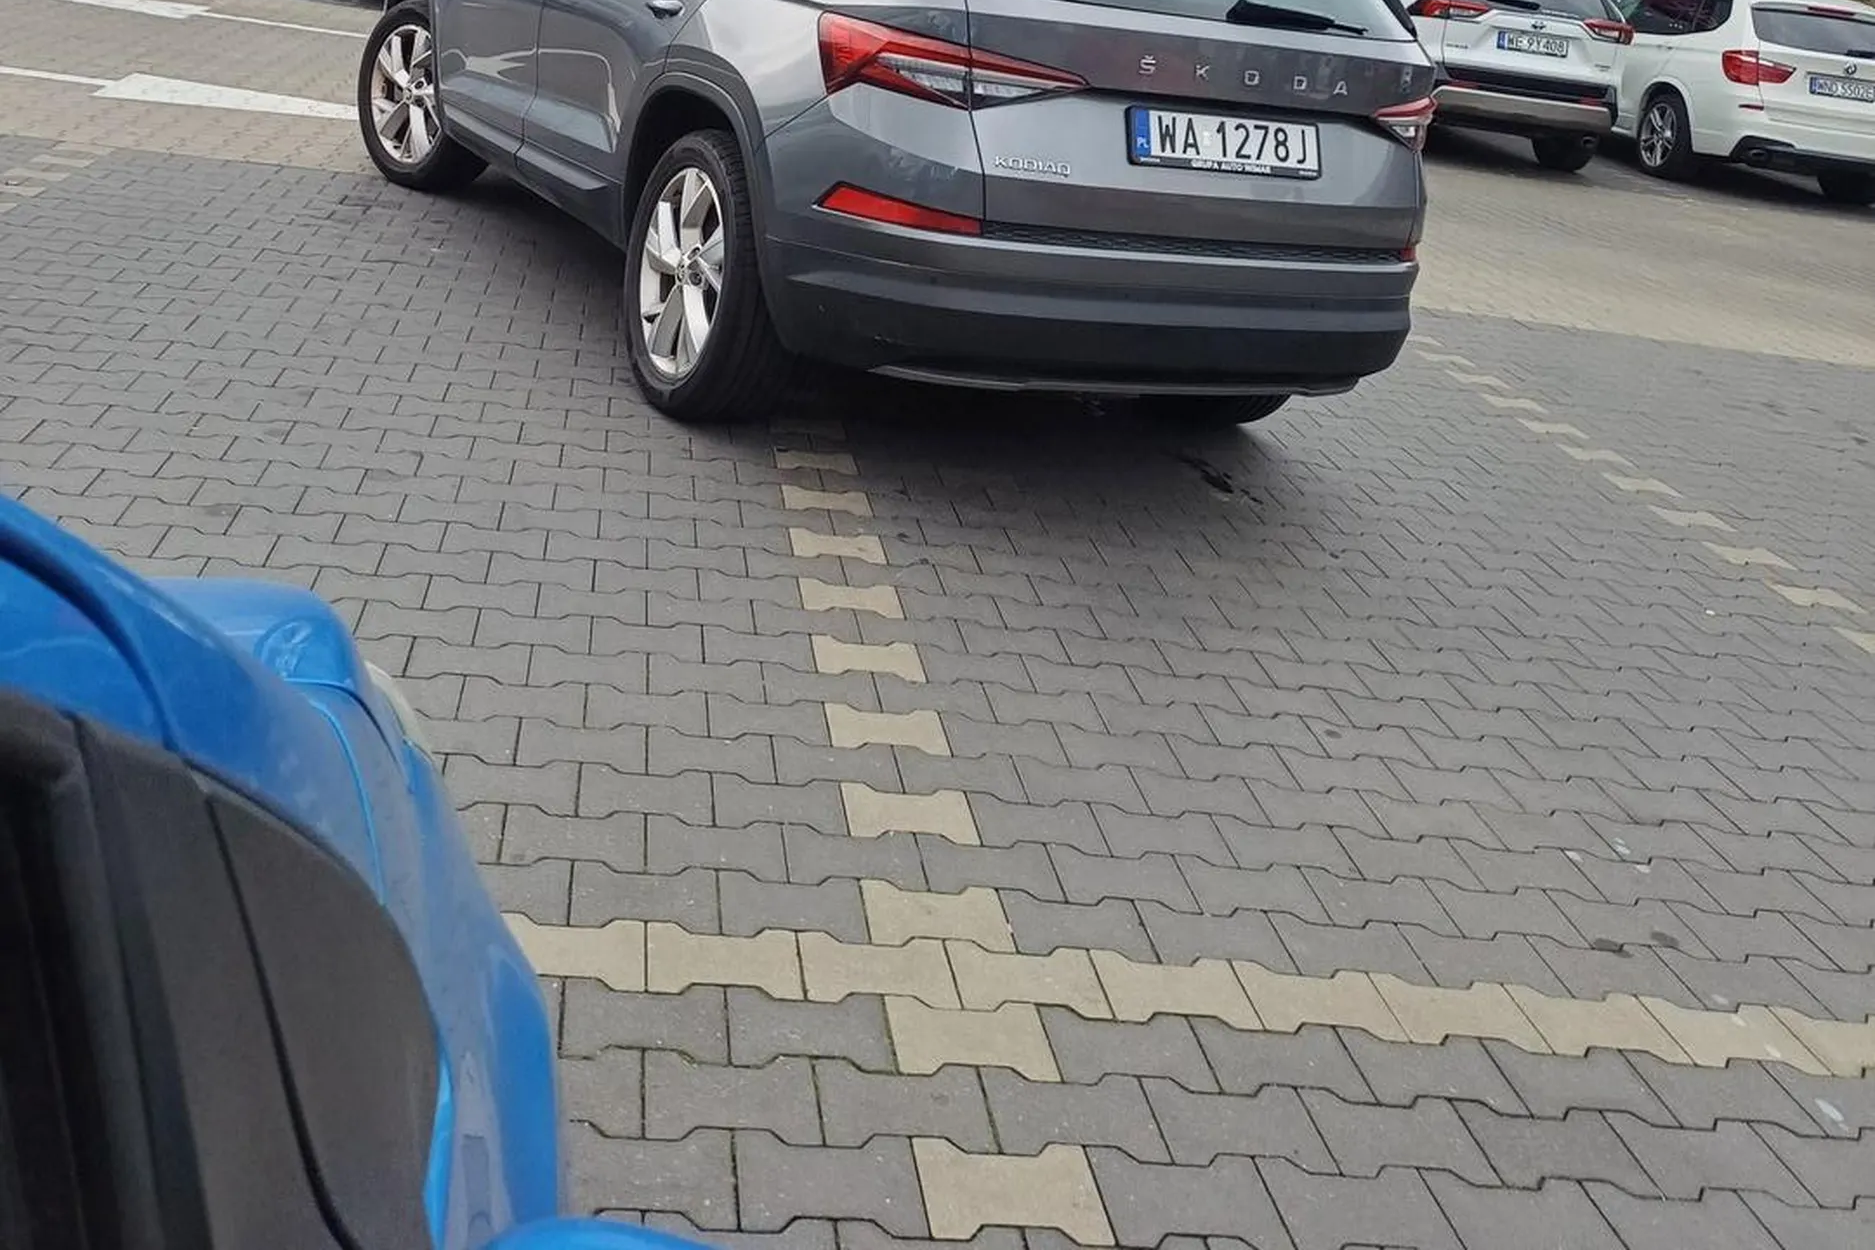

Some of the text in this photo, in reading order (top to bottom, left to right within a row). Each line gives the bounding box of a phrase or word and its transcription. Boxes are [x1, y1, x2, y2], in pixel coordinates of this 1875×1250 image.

[1138, 54, 1348, 96] ŠKODA
[1136, 136, 1149, 149] PL
[1157, 115, 1307, 165] WA 1278J
[994, 155, 1071, 178] KODIAQ
